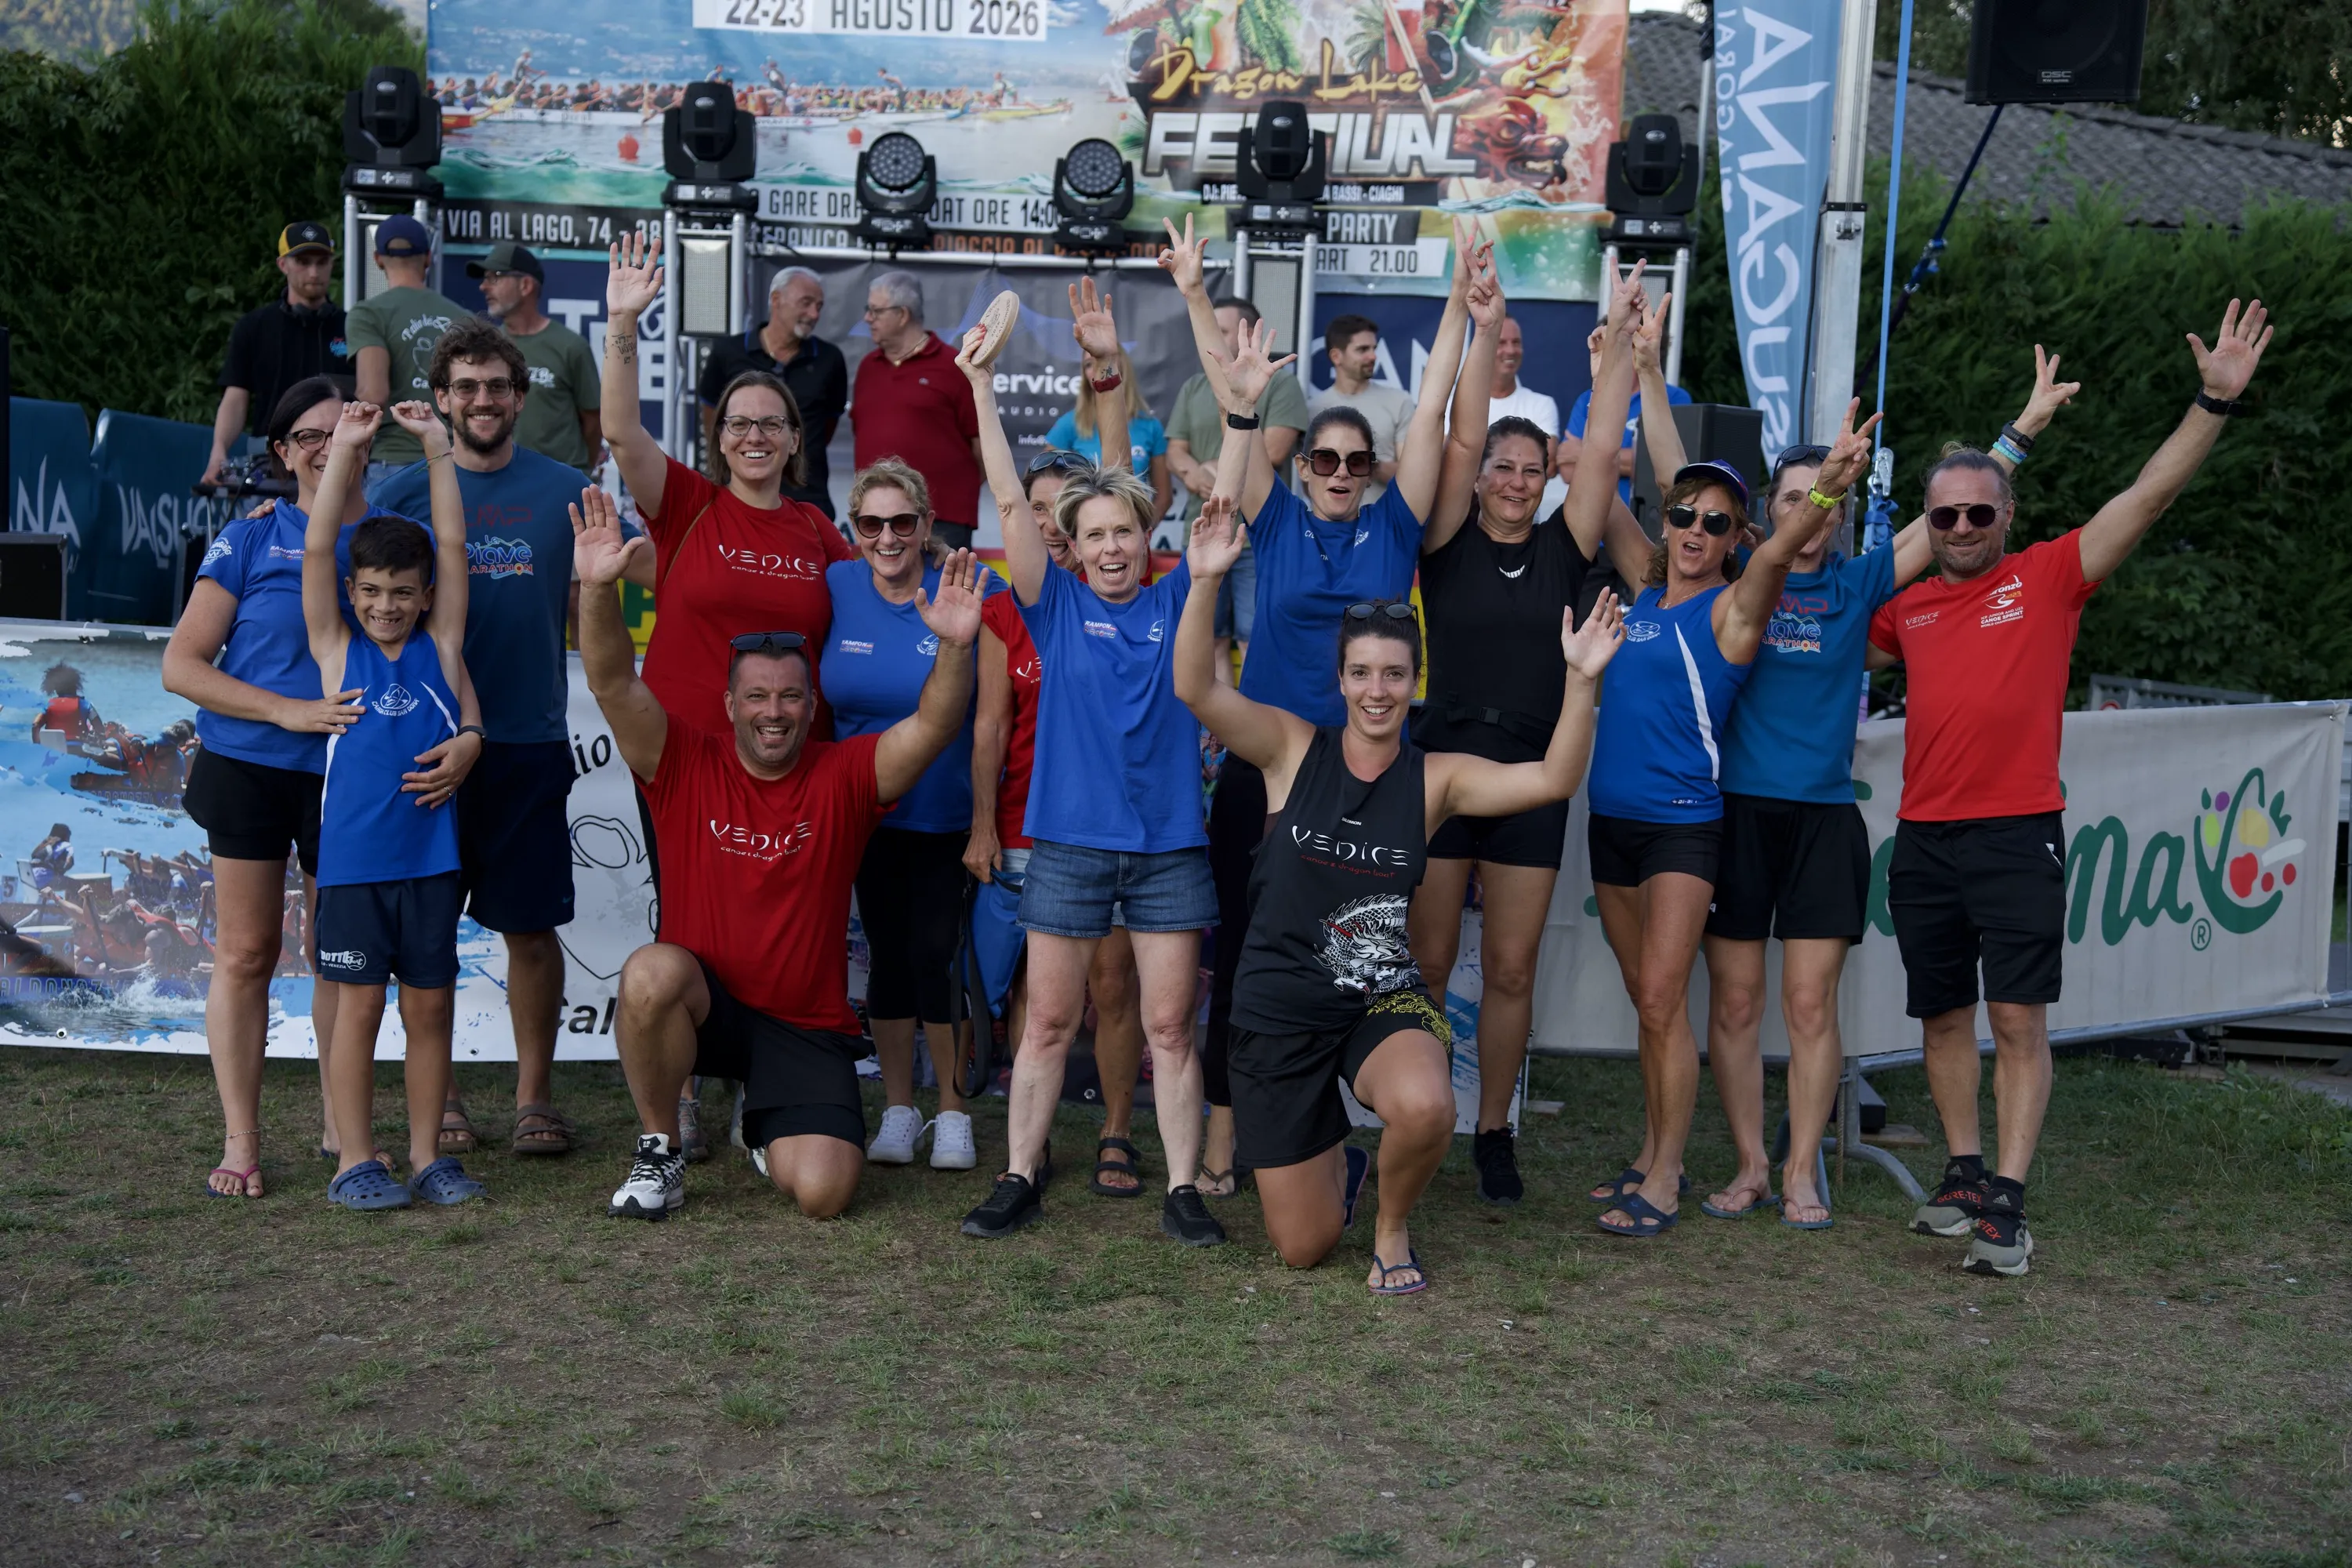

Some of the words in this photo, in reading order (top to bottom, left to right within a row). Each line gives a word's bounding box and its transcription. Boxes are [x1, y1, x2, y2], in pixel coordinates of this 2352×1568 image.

[967, 0, 1040, 37] 2026
[1149, 45, 1305, 102] Dragon
[1313, 37, 1424, 103] Lake
[1144, 111, 1478, 175] FEIVAL
[768, 188, 818, 217] GARE
[973, 198, 1010, 225] ORE
[1021, 198, 1058, 228] 14:0
[447, 209, 482, 238] VIA
[489, 211, 514, 240] AL
[587, 216, 612, 245] 74
[1326, 211, 1399, 244] PARTY
[1316, 248, 1349, 273] ART
[1369, 249, 1419, 274] 21.00
[993, 365, 1083, 395] ervice
[468, 563, 533, 575] ARATHON
[718, 544, 821, 575] VENICE
[1084, 620, 1111, 629] RAMPON
[1980, 615, 2001, 624] CANOE
[2002, 610, 2024, 619] SPRINT
[1761, 635, 1820, 650] ARATHON
[710, 819, 813, 851] VENICE
[1291, 825, 1411, 866] VENICE
